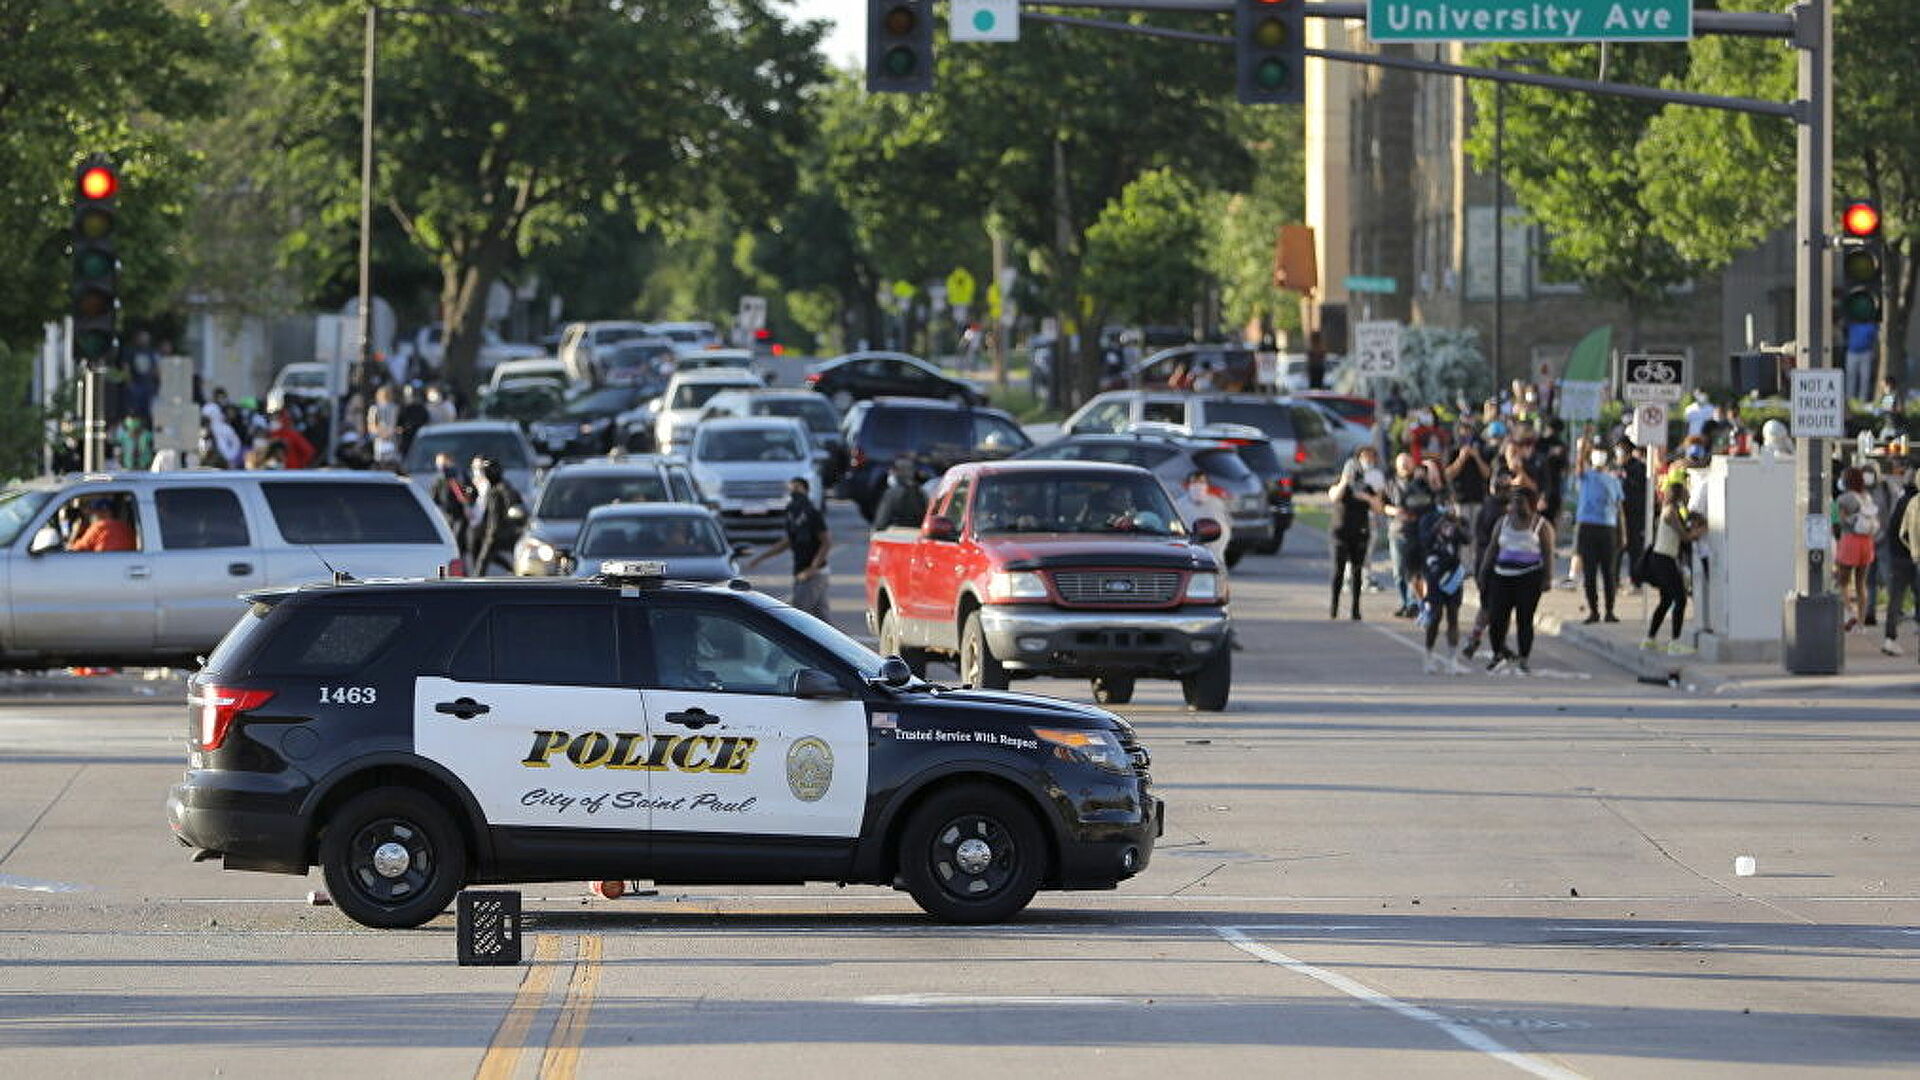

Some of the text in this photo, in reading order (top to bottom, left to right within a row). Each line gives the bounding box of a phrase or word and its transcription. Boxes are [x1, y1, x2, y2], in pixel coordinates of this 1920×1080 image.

[1387, 3, 1672, 35] University Ave
[1360, 350, 1396, 371] 25
[1799, 379, 1836, 393] NOT A
[1799, 396, 1838, 410] TRUCK
[1798, 414, 1836, 428] ROUTE
[319, 687, 377, 704] 1463
[894, 728, 1038, 749] Trusted Service With Respect
[520, 730, 758, 775] POLICE
[520, 788, 758, 814] City of Saint Paul
